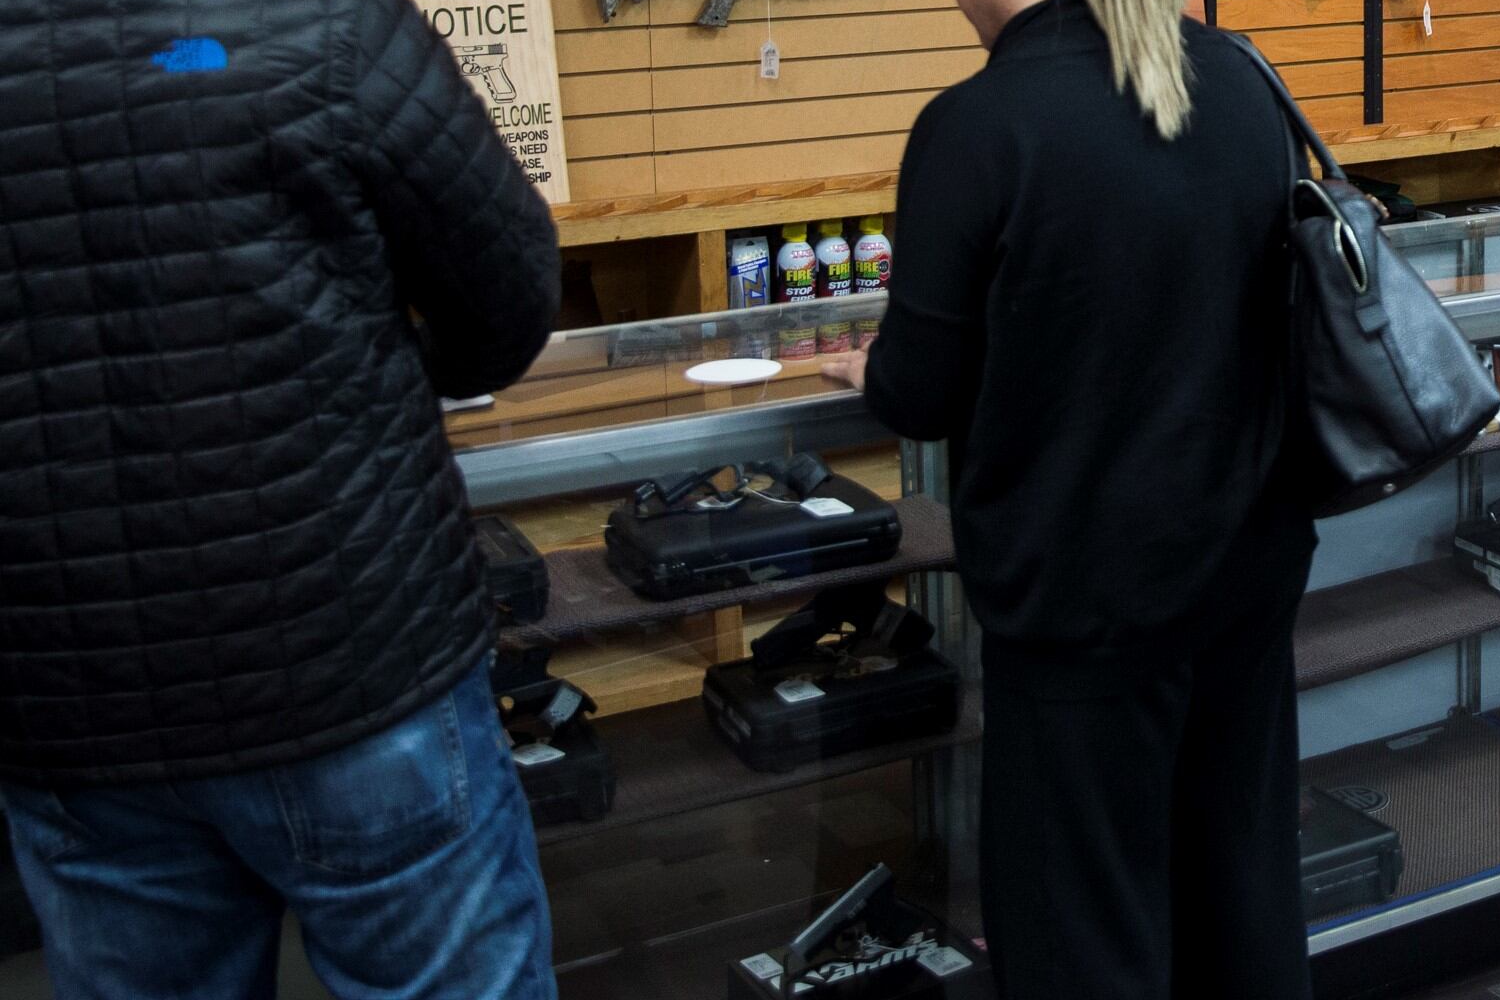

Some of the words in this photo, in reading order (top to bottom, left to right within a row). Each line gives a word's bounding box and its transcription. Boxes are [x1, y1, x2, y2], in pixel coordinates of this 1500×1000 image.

[423, 3, 528, 39] OTICE
[488, 103, 553, 128] ELCOME
[520, 143, 548, 155] NEED
[521, 158, 545, 169] ASE,
[786, 269, 812, 281] FIRE
[856, 279, 880, 287] STOP
[786, 287, 813, 296] STOP
